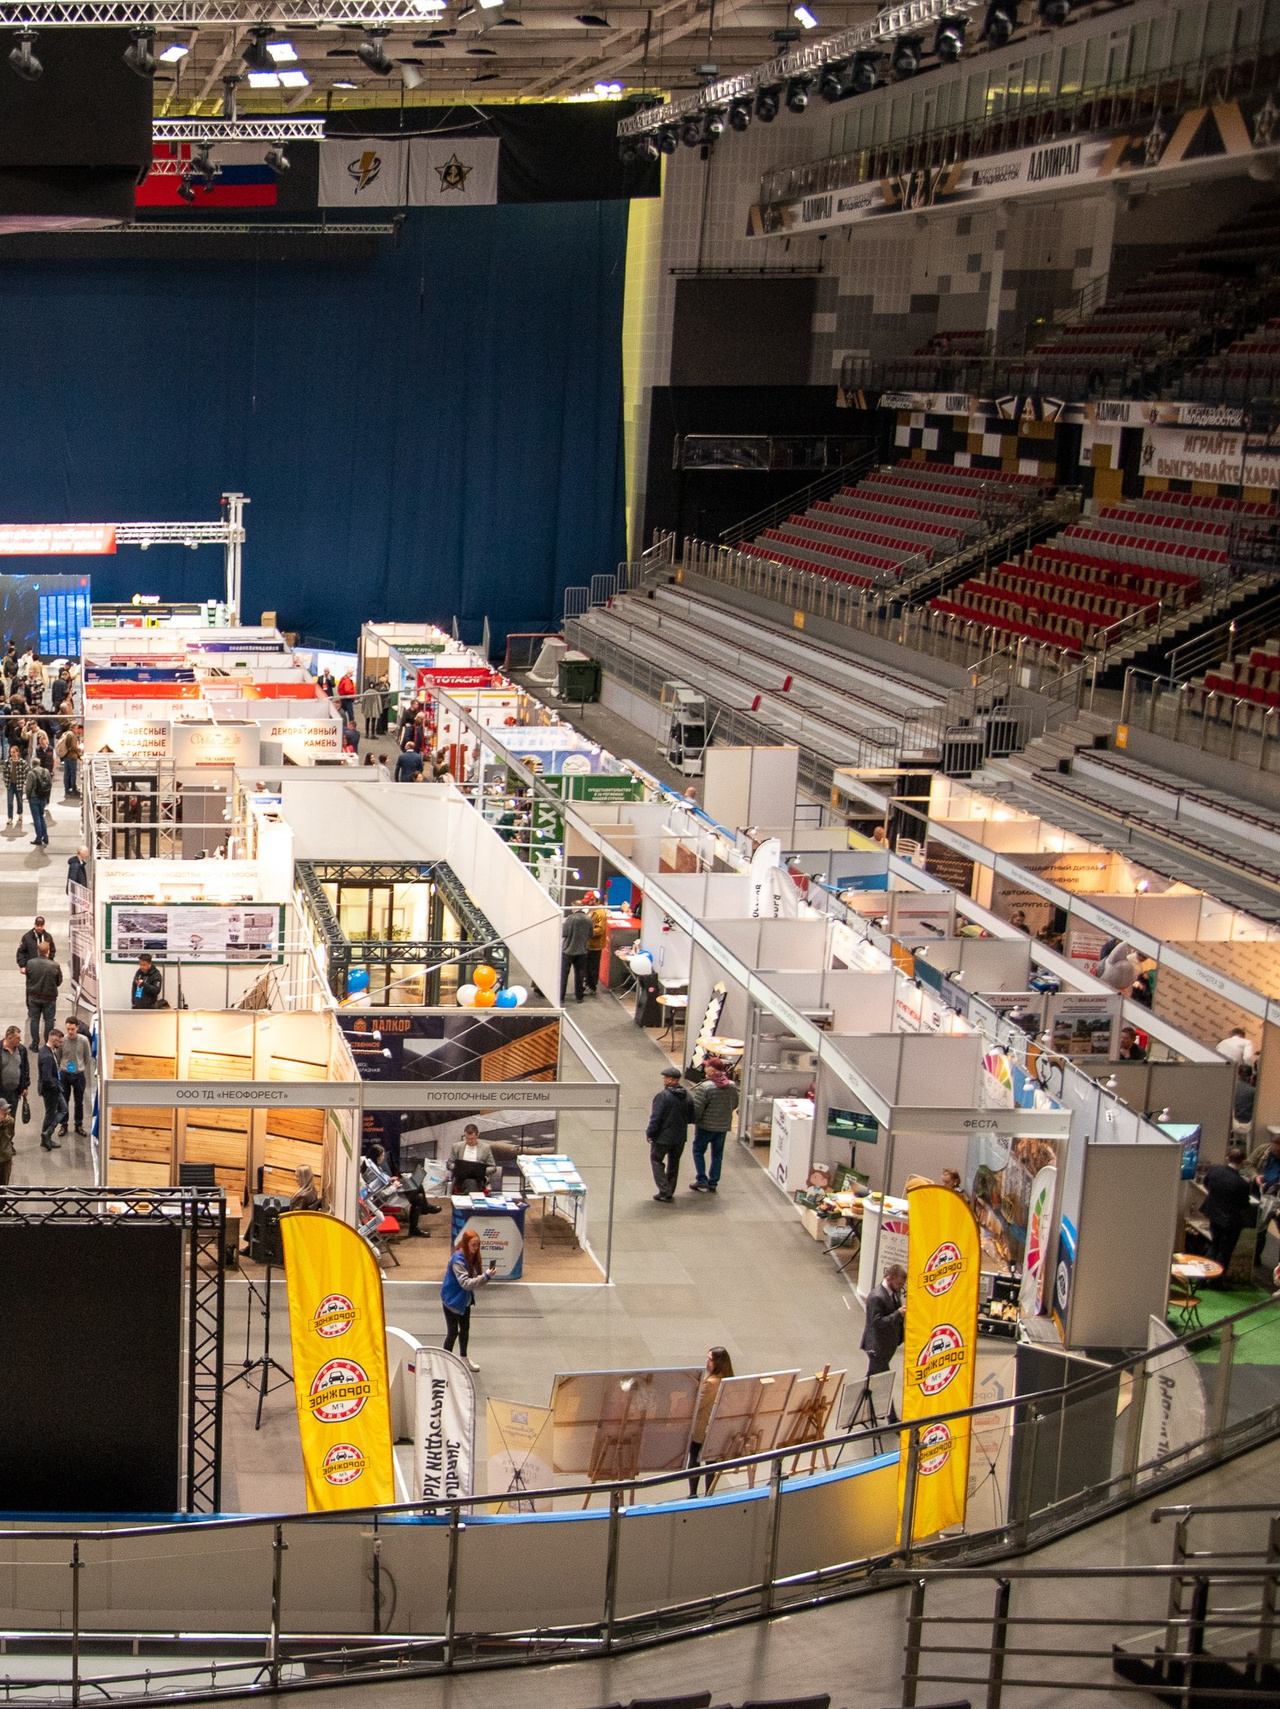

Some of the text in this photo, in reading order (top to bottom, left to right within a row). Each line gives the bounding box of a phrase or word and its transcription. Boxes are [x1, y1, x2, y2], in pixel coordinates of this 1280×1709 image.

[1027, 142, 1081, 183] АДМИРАЛ
[1183, 433, 1238, 456] ИГРАЙТЕ
[1157, 458, 1241, 482] ВЫИГРЫВАЙТЕ
[436, 675, 481, 684] TOTACHI
[271, 726, 337, 737] ДЕКОРАТИВНЫЙ
[119, 739, 167, 747] ФАСАДНЫЕ
[371, 1019, 411, 1032] ДАЛКОР
[176, 1090, 199, 1099] ООО
[202, 1090, 214, 1100] ТД
[216, 1090, 289, 1099] «НЕОФОРЕСТ»
[427, 1092, 497, 1101] ПОТОЛОЧНЫЕ
[499, 1092, 550, 1101] СИСТЕМЫ
[963, 1119, 998, 1130] ФЕСТА
